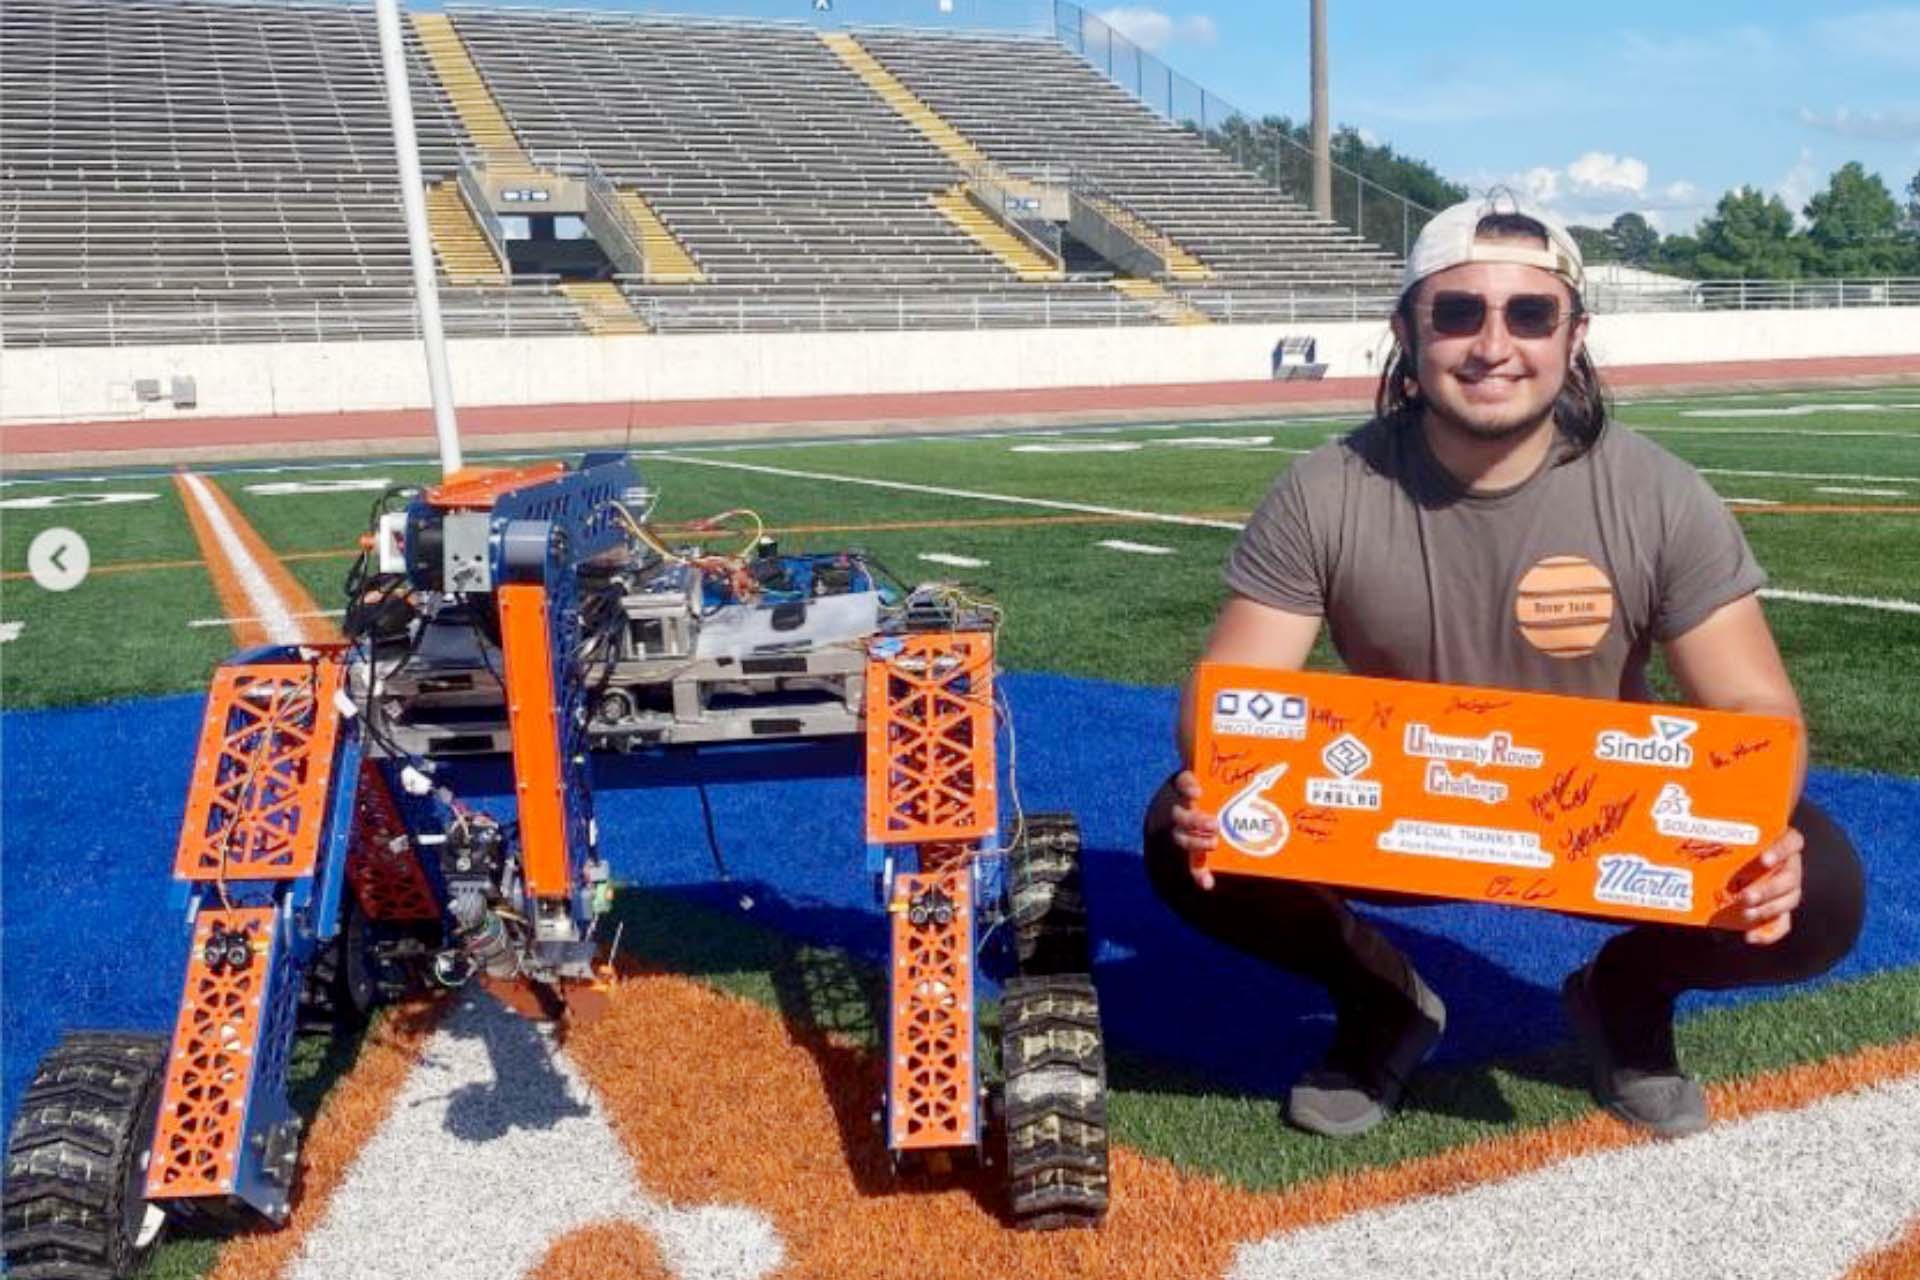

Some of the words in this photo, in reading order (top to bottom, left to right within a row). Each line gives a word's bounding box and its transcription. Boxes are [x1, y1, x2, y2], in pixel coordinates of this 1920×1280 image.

[1409, 725, 1486, 764] University
[1492, 734, 1541, 766] Rover
[1600, 733, 1690, 765] Sindoh
[1429, 764, 1505, 801] Challenge
[1233, 816, 1273, 833] MAE
[1398, 822, 1455, 841] SPECIAL
[1459, 828, 1515, 846] THANKS
[1520, 835, 1538, 849] TO
[1600, 858, 1689, 898] Martin
